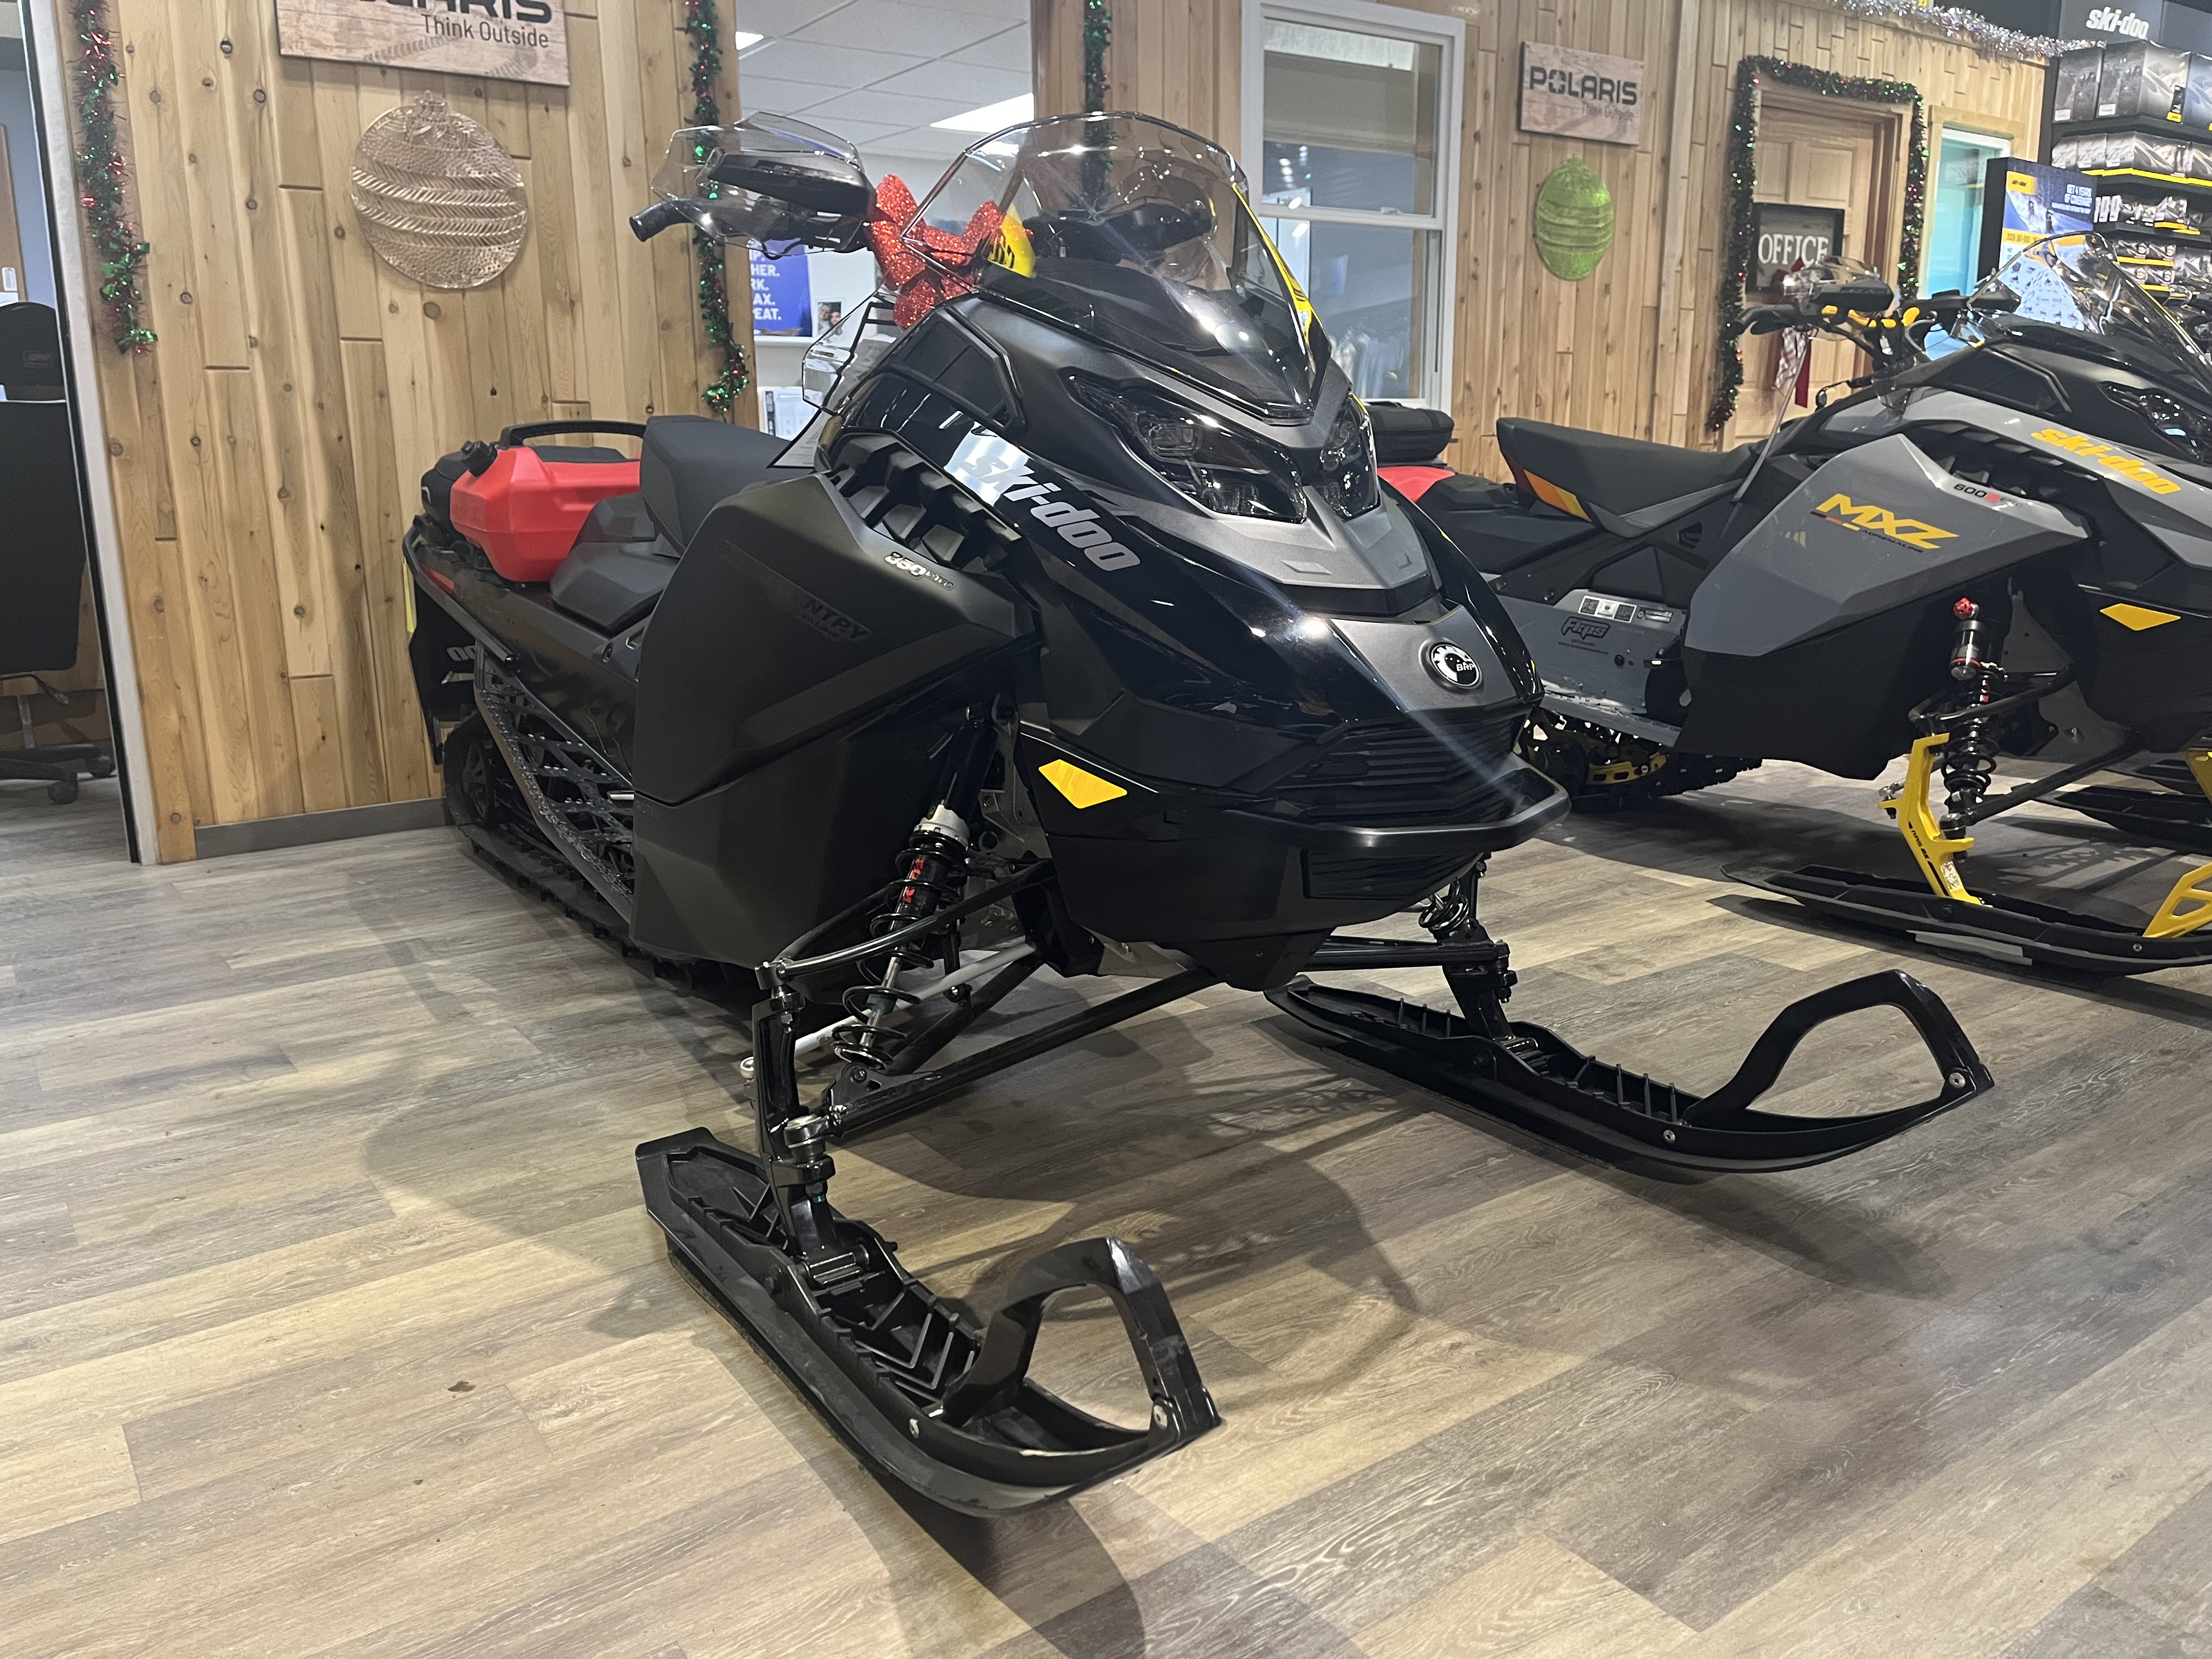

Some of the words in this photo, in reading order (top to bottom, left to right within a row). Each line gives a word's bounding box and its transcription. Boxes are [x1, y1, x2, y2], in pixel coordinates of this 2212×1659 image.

[421, 14, 474, 40] Think
[479, 21, 549, 48] Outside
[2086, 7, 2149, 40] ski-doo
[1530, 65, 1637, 105] POLARIS
[1758, 233, 1829, 268] OFFICE
[2031, 429, 2181, 494] ski-doo
[960, 454, 1141, 572] ski-doo
[1816, 493, 1959, 549] MXZ
[1456, 662, 1475, 672] BRP
